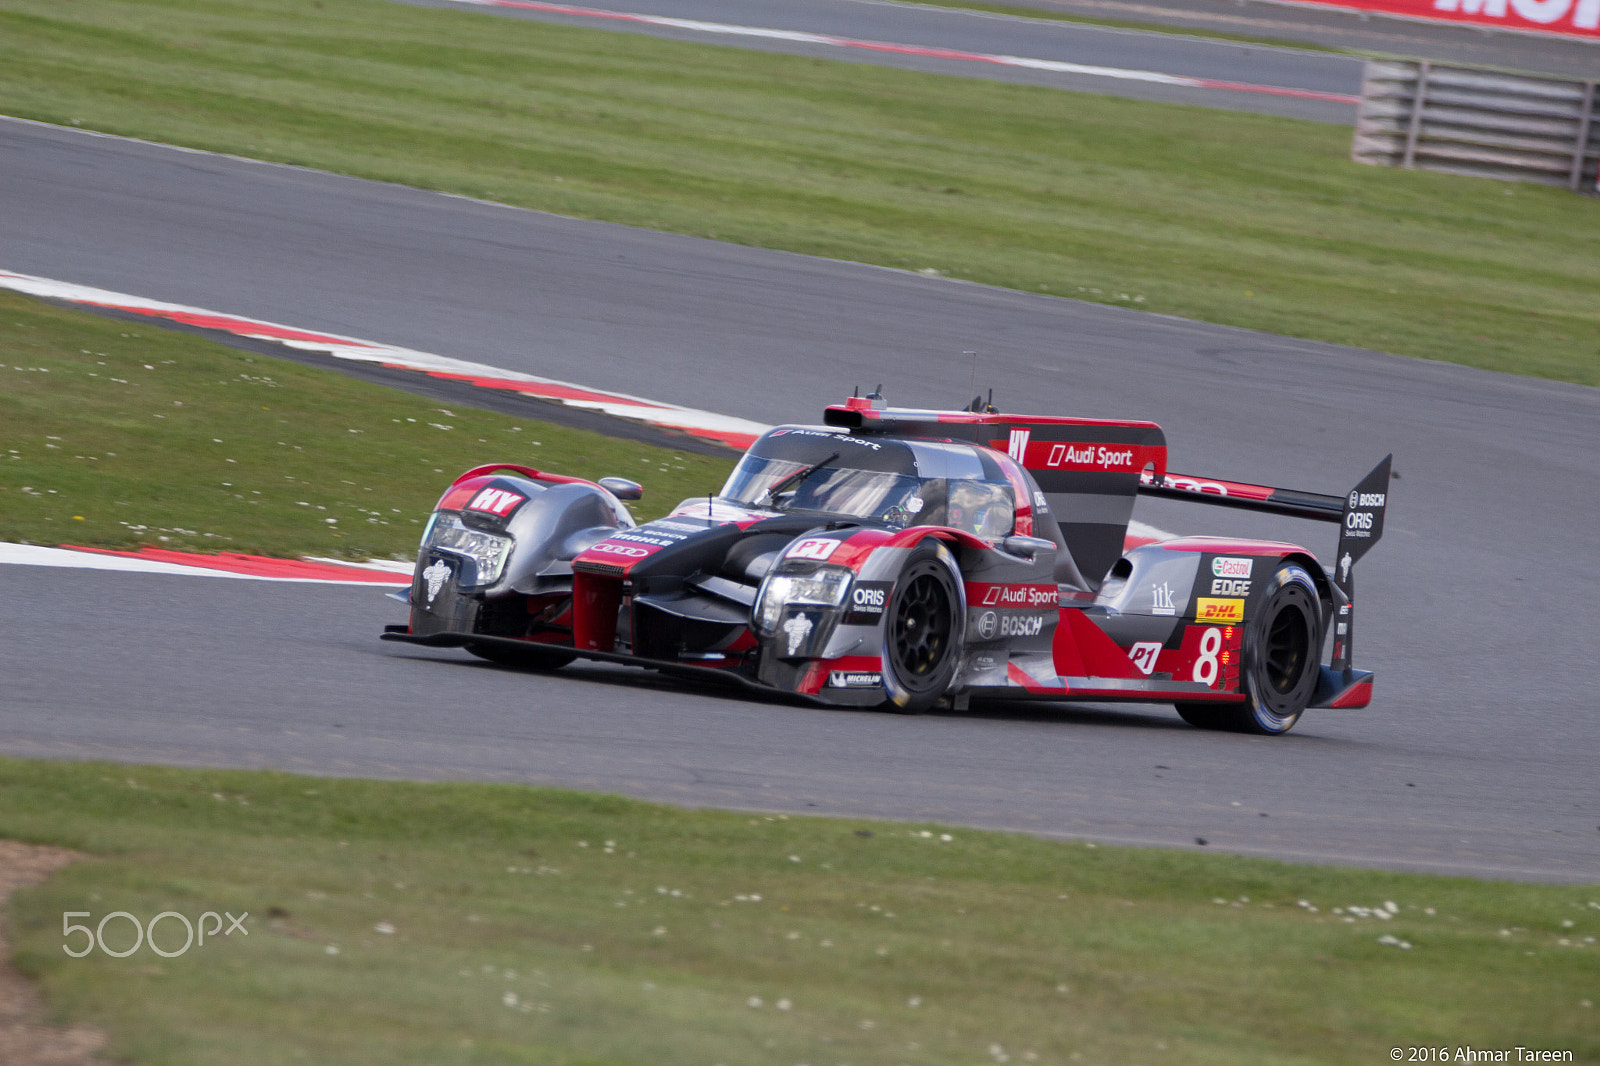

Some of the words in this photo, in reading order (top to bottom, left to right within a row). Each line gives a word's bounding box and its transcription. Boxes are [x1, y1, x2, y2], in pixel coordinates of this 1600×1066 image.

[833, 434, 882, 451] Sport
[1008, 429, 1031, 465] HY
[1064, 445, 1095, 464] Audi
[1096, 446, 1134, 469] Sport
[470, 487, 522, 513] HY
[1359, 493, 1386, 507] BOSCH
[1346, 511, 1374, 529] ORIS
[1222, 560, 1249, 576] Castrol
[853, 588, 885, 606] ORIS
[1000, 586, 1027, 602] Audi
[1028, 587, 1058, 607] Sport
[1151, 581, 1176, 608] itk
[1210, 579, 1252, 597] EDGE
[1205, 604, 1236, 618] DHL
[1000, 615, 1043, 636] BOSCH
[1131, 647, 1156, 670] P1
[1192, 626, 1222, 687] 8
[846, 674, 881, 684] MICHELIN
